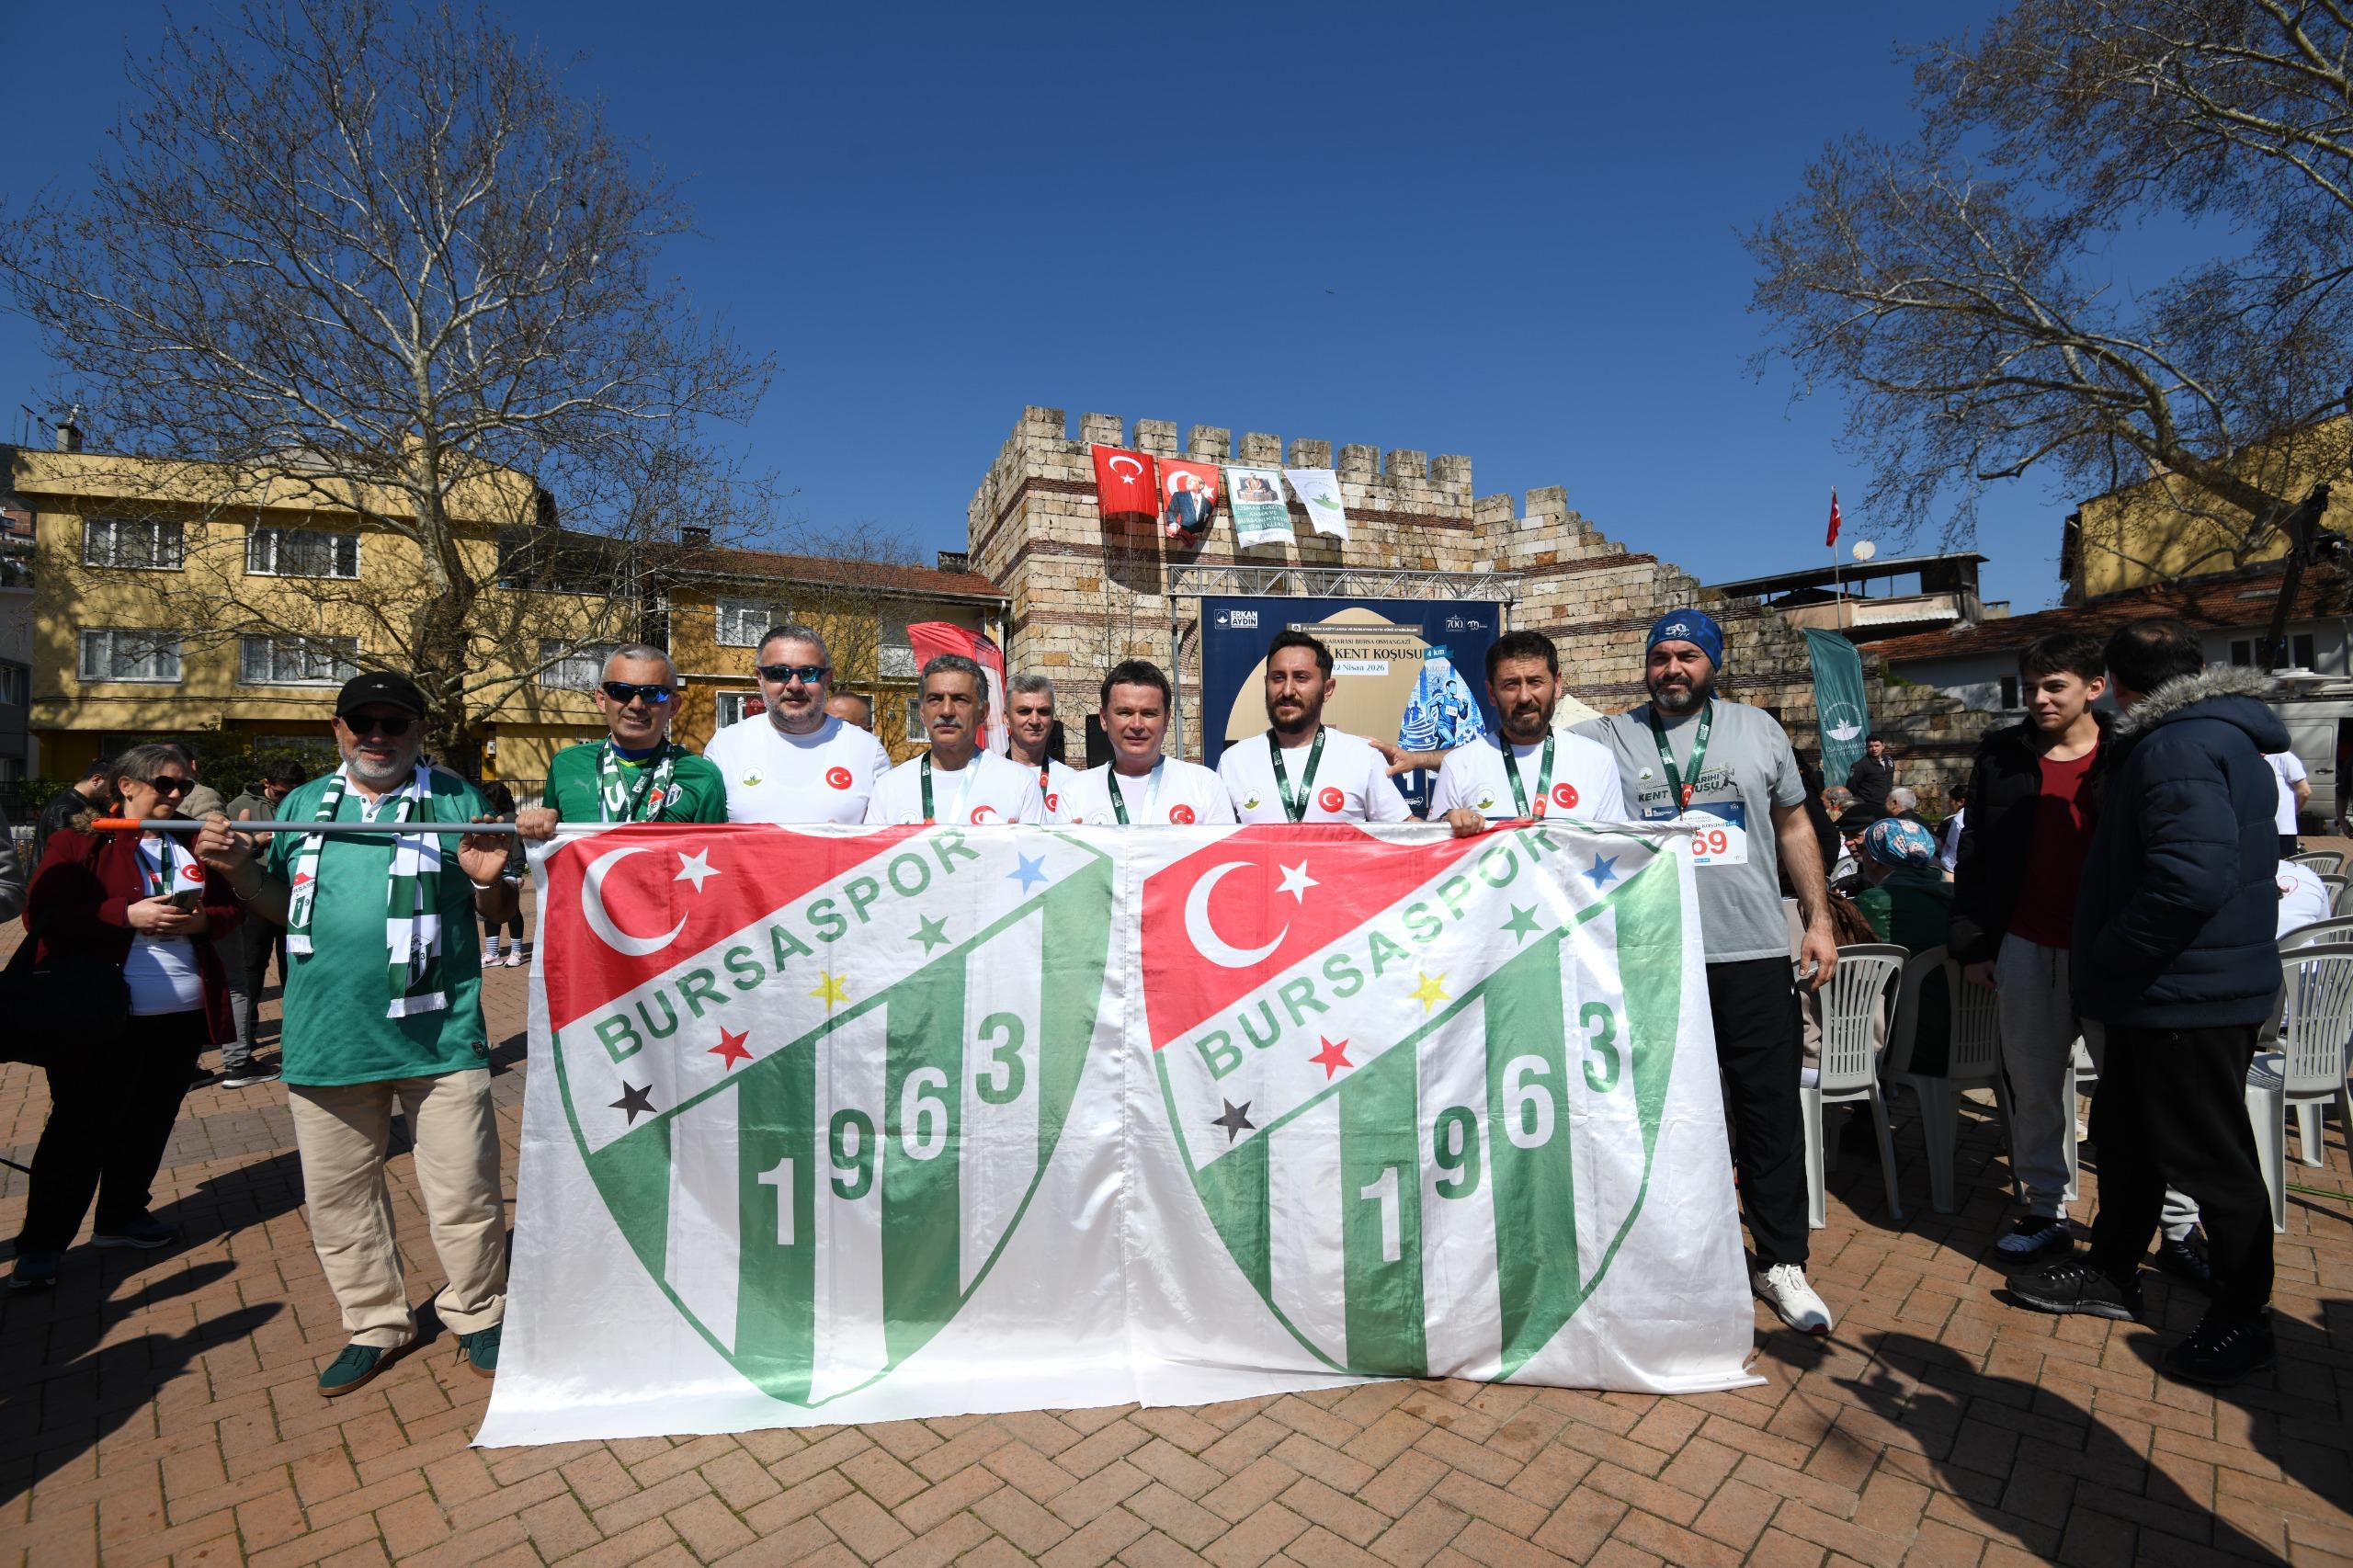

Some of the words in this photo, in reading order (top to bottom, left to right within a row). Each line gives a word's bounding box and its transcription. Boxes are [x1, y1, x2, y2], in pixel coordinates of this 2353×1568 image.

[1335, 648, 1370, 659] KENT
[1373, 648, 1422, 662] KOŞUSU
[1638, 790, 1668, 801] KENT
[1695, 781, 1719, 792] USU
[294, 881, 314, 892] RSASP
[297, 899, 310, 910] 19
[593, 828, 981, 1064] BURSASPOR
[1196, 826, 1561, 1081] BURSASPOR
[413, 953, 426, 964] 63
[757, 1012, 1026, 1245] 1963
[1361, 1001, 1620, 1262] 1963
